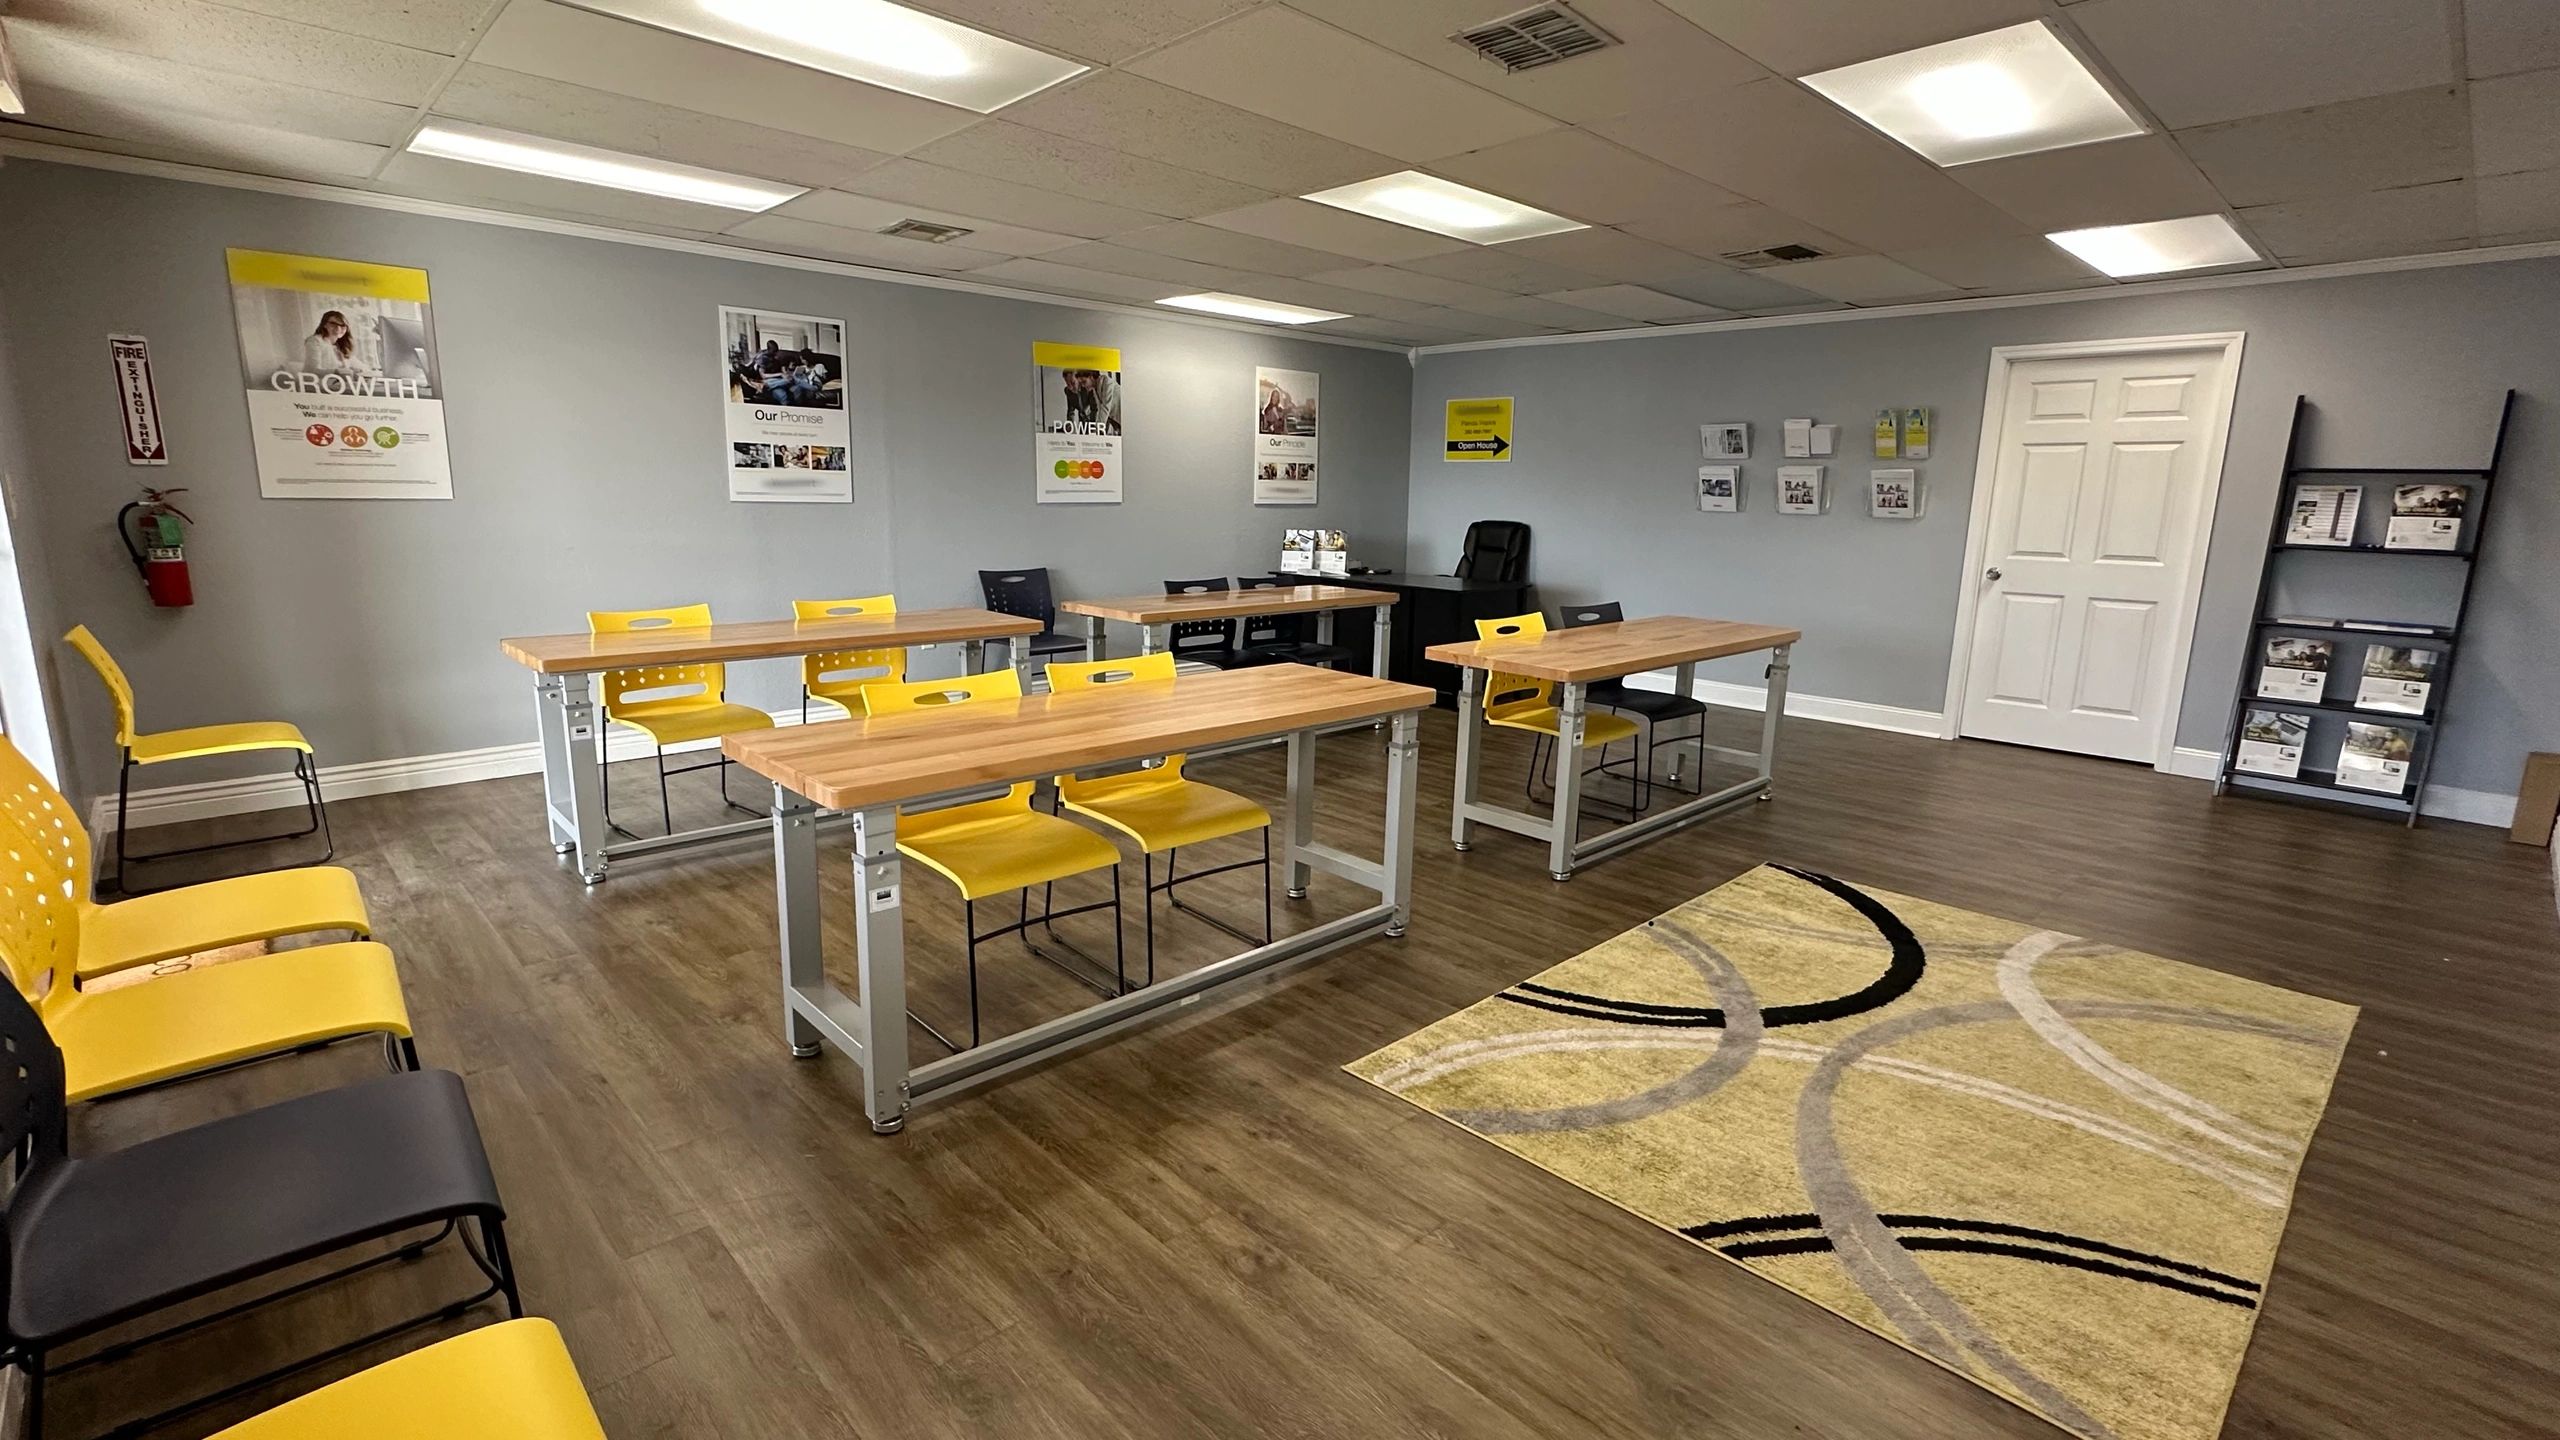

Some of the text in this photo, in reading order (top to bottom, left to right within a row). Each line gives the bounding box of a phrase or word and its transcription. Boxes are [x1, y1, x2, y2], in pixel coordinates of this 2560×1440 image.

[115, 346, 145, 359] FIRE
[270, 370, 419, 399] GROWTH
[127, 361, 153, 453] EXTINGUISHER
[293, 402, 310, 410] You
[754, 409, 824, 424] Our Promise
[1053, 420, 1107, 436] POWER
[1269, 438, 1282, 447] Our
[1457, 441, 1499, 450] Open House
